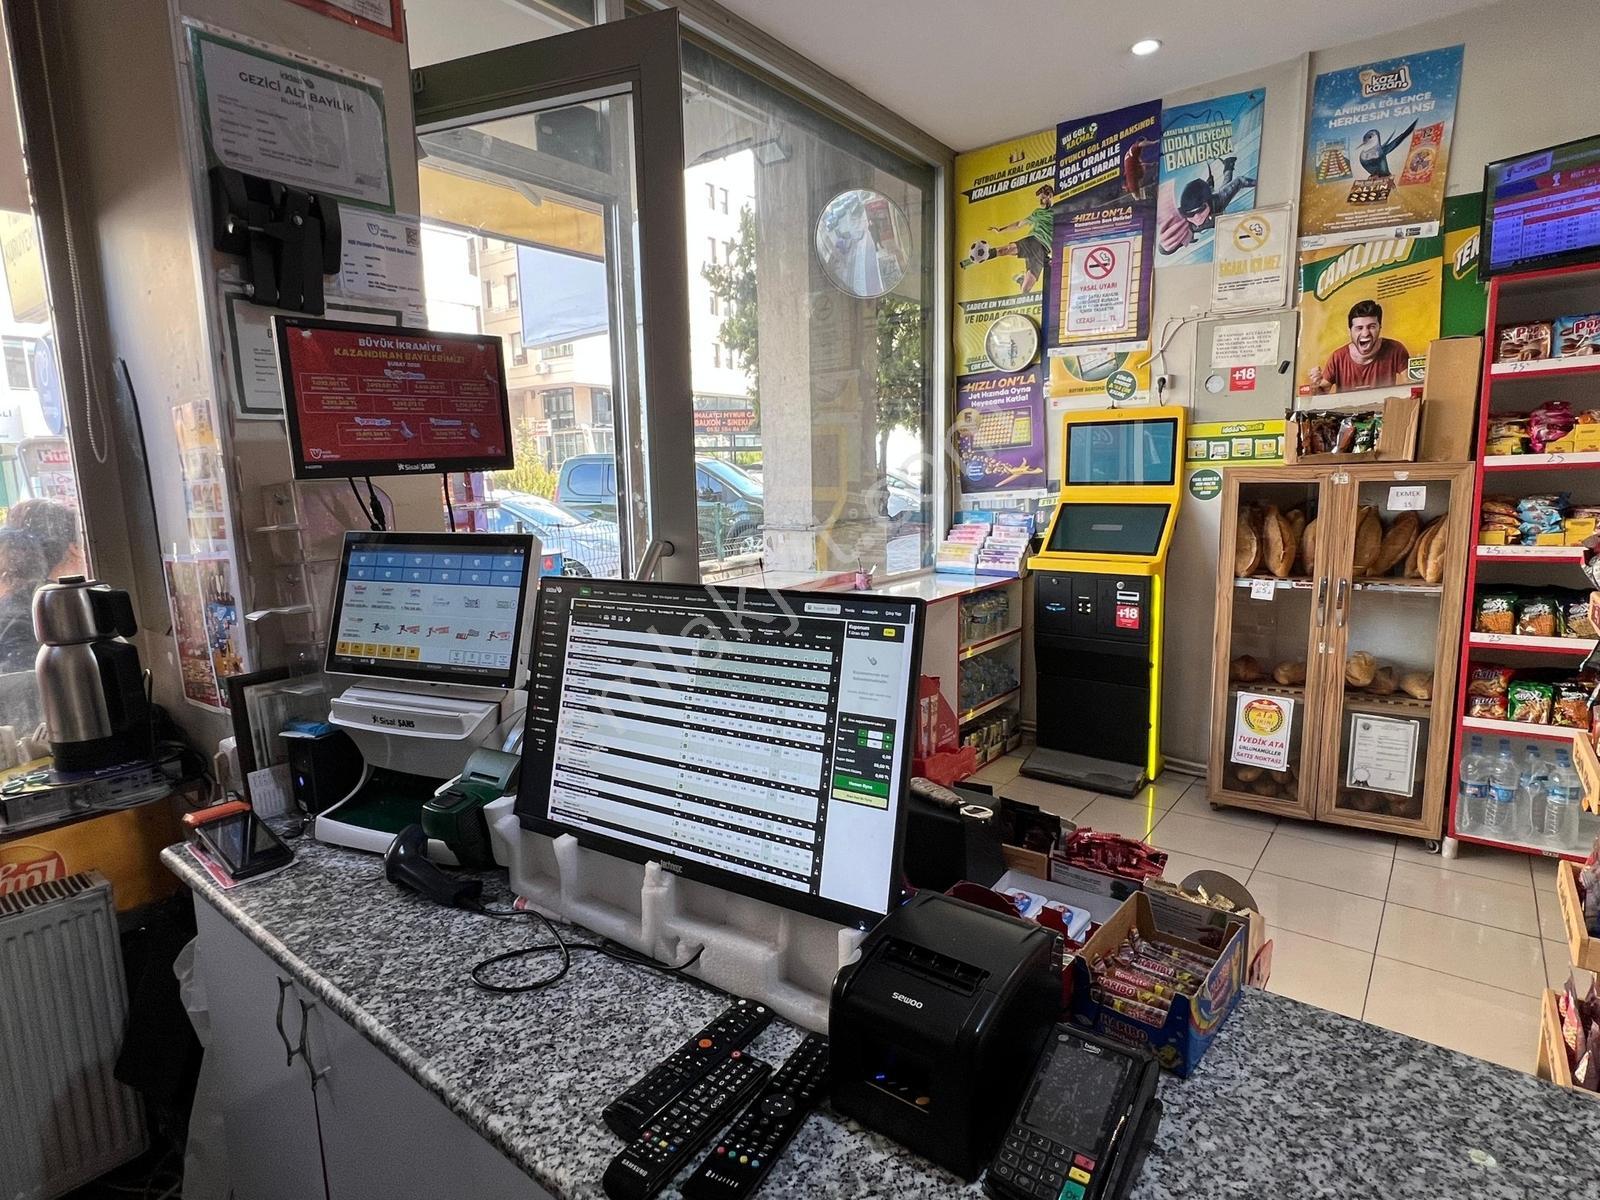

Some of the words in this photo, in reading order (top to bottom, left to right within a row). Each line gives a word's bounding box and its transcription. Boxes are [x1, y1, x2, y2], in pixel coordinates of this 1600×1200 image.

[1365, 69, 1409, 95] kazan!
[1372, 72, 1400, 86] kazı
[239, 71, 282, 92] GEZİCİ
[284, 86, 306, 99] ALT
[310, 92, 355, 114] BAYİLİK
[1334, 101, 1376, 117] ANINDA
[1378, 92, 1432, 108] EĞLENCE
[1328, 110, 1390, 129] HERKESİN
[1062, 133, 1072, 146] BU
[1073, 128, 1086, 139] GOL
[1196, 126, 1233, 147] HEYECANI
[1059, 151, 1086, 167] OYUNCU
[1087, 144, 1101, 156] GOL
[1101, 135, 1119, 148] ATAR
[1165, 142, 1235, 172] BAMBAŞKA
[1059, 164, 1082, 180] KRAL
[1082, 153, 1106, 170] ORAN
[1059, 171, 1091, 190] %50'YE
[1091, 155, 1121, 176] VARAN
[973, 170, 1006, 187] FUTBOLDA
[1007, 165, 1024, 179] KRAL
[971, 182, 1009, 200] KRALLAR
[1010, 175, 1028, 189] GİBİ
[1355, 184, 1389, 193] ALTIN
[1072, 210, 1100, 223] HIZLI
[1101, 206, 1133, 219] ON'LA
[1080, 284, 1099, 293] YASAL
[1100, 282, 1118, 291] UYARI
[966, 302, 988, 312] SADECE
[988, 301, 997, 309] EN
[997, 299, 1016, 309] YAKIN
[1034, 294, 1043, 303] BA
[965, 314, 975, 324] VE
[1032, 306, 1042, 315] CE
[358, 337, 394, 349] BÜYÜK
[396, 339, 443, 352] İKRAMİYE
[333, 348, 403, 360] KAZANDIRAN
[963, 378, 997, 392] HIZLI
[998, 373, 1036, 387] ON'LA
[1232, 368, 1256, 380] +18
[968, 391, 981, 401] Jet
[981, 388, 1009, 399] Hızında
[1010, 385, 1031, 397] Oyna
[971, 398, 1005, 409] Heyecanı
[1006, 393, 1029, 404] Katla!
[1395, 489, 1421, 498] EKMEK
[1116, 607, 1139, 619] +18
[848, 623, 870, 632] Kuponum
[379, 716, 396, 726] Sisal
[1238, 735, 1266, 746] İVEDİK
[1267, 739, 1284, 750] ATA
[1236, 752, 1253, 762] SATIŞ
[1254, 754, 1282, 765] NOKTASI
[1137, 957, 1175, 977] HARIBO
[1097, 976, 1137, 997] HARIBO
[1114, 970, 1149, 987] Roulette
[891, 991, 923, 1010] sewoo
[1083, 1042, 1102, 1054] beko
[621, 1158, 648, 1178] SAMSUNG
[1027, 1164, 1033, 1172] 8
[1049, 1174, 1055, 1182] 9
